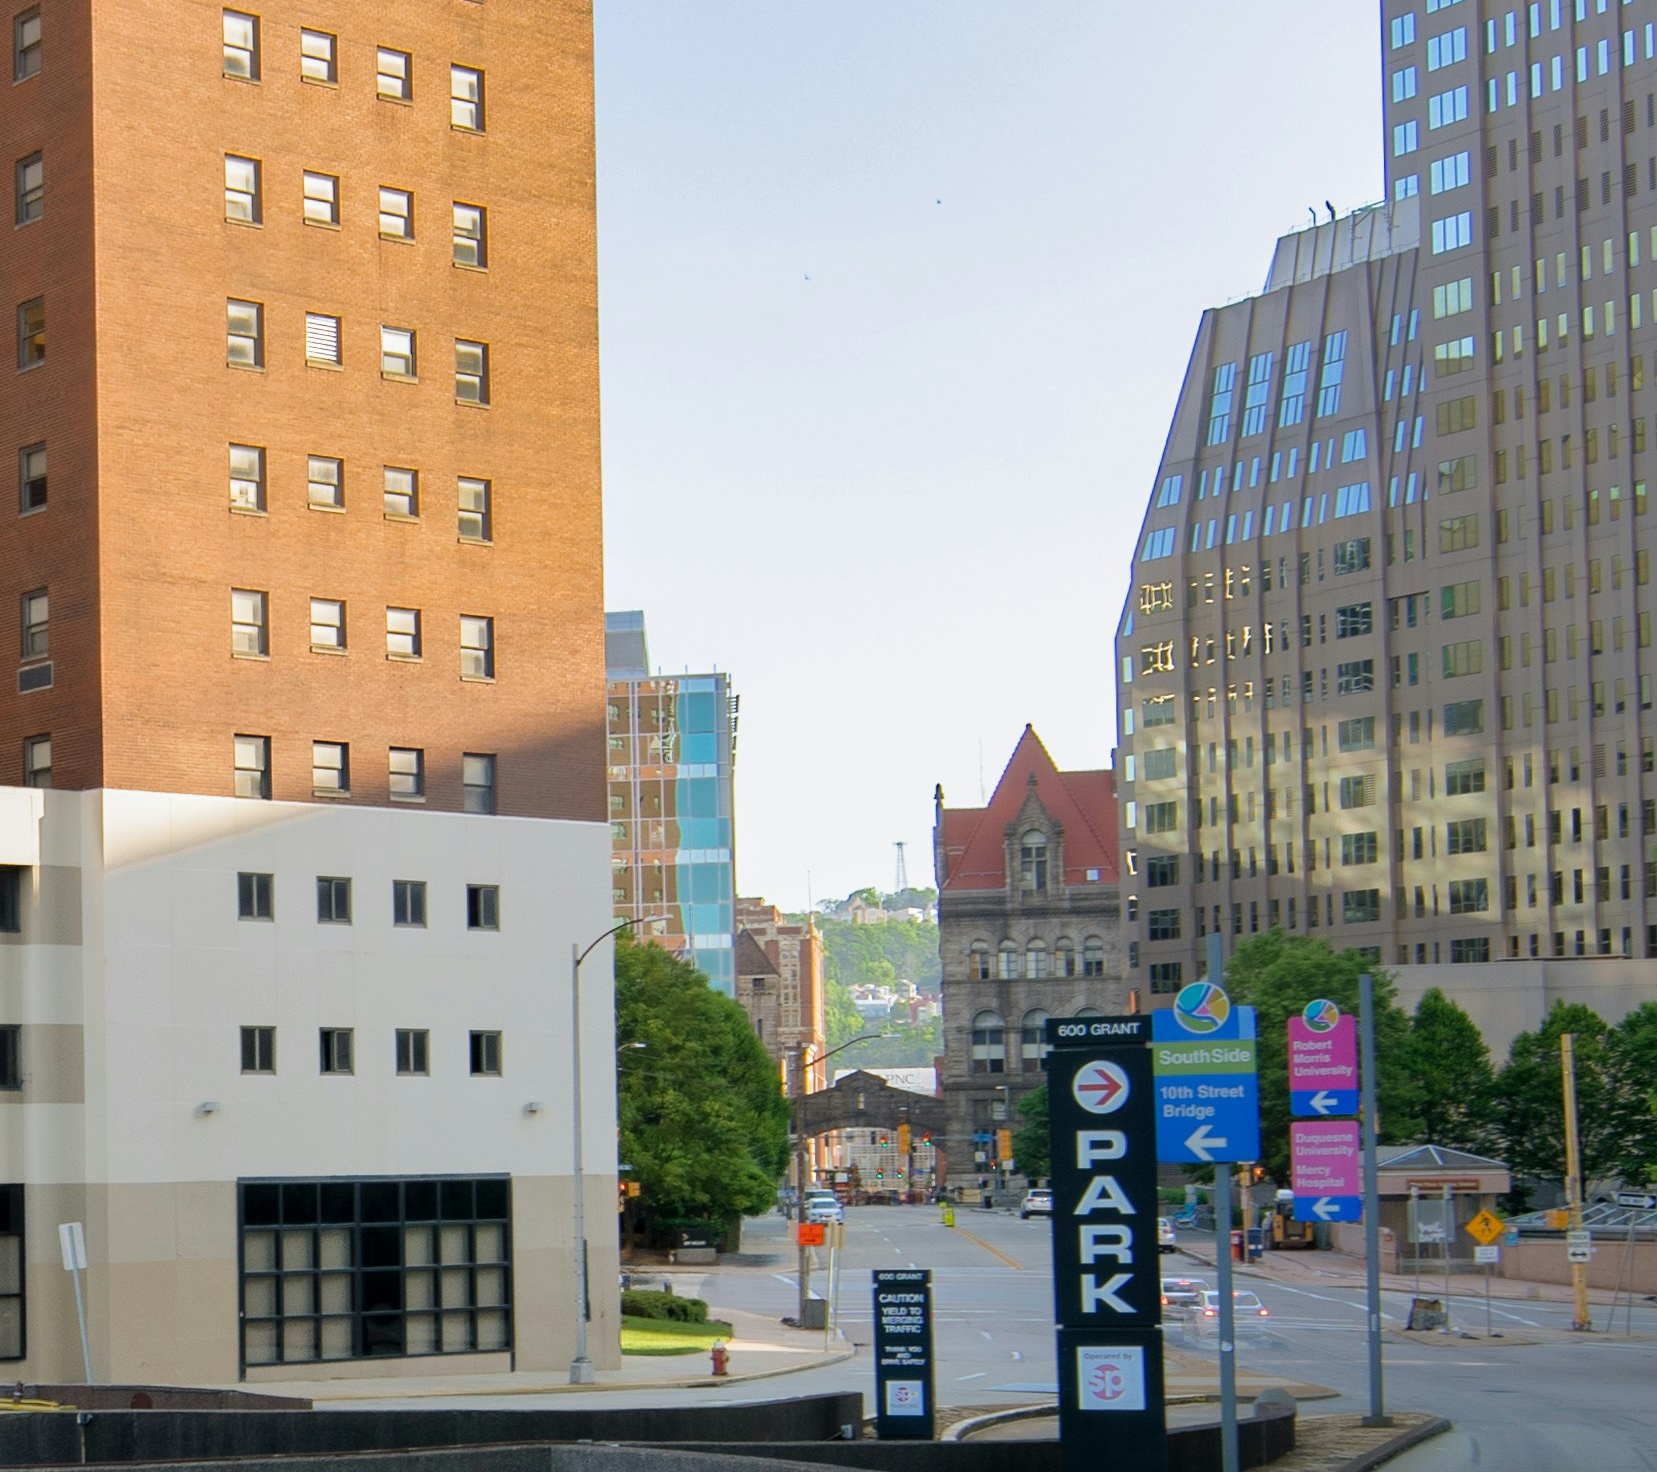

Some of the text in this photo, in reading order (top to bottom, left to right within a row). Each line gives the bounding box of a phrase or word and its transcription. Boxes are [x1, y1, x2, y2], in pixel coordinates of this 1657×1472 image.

[1058, 1022, 1141, 1036] 600 GRANT
[1293, 1040, 1333, 1051] Robert
[1294, 1053, 1331, 1063] Morris
[1294, 1065, 1353, 1077] University
[1160, 1084, 1245, 1099] 10th Street
[1163, 1104, 1215, 1120] Bridge
[1295, 1133, 1353, 1145] Duquesne
[1295, 1145, 1355, 1157] University
[1296, 1165, 1331, 1176] Mercy
[1296, 1177, 1345, 1189] Hospital
[1073, 1130, 1137, 1314] PARK
[879, 1293, 925, 1304] CAUTION
[882, 1307, 922, 1316] YIELD TO
[884, 1324, 922, 1334] TRAFFIC
